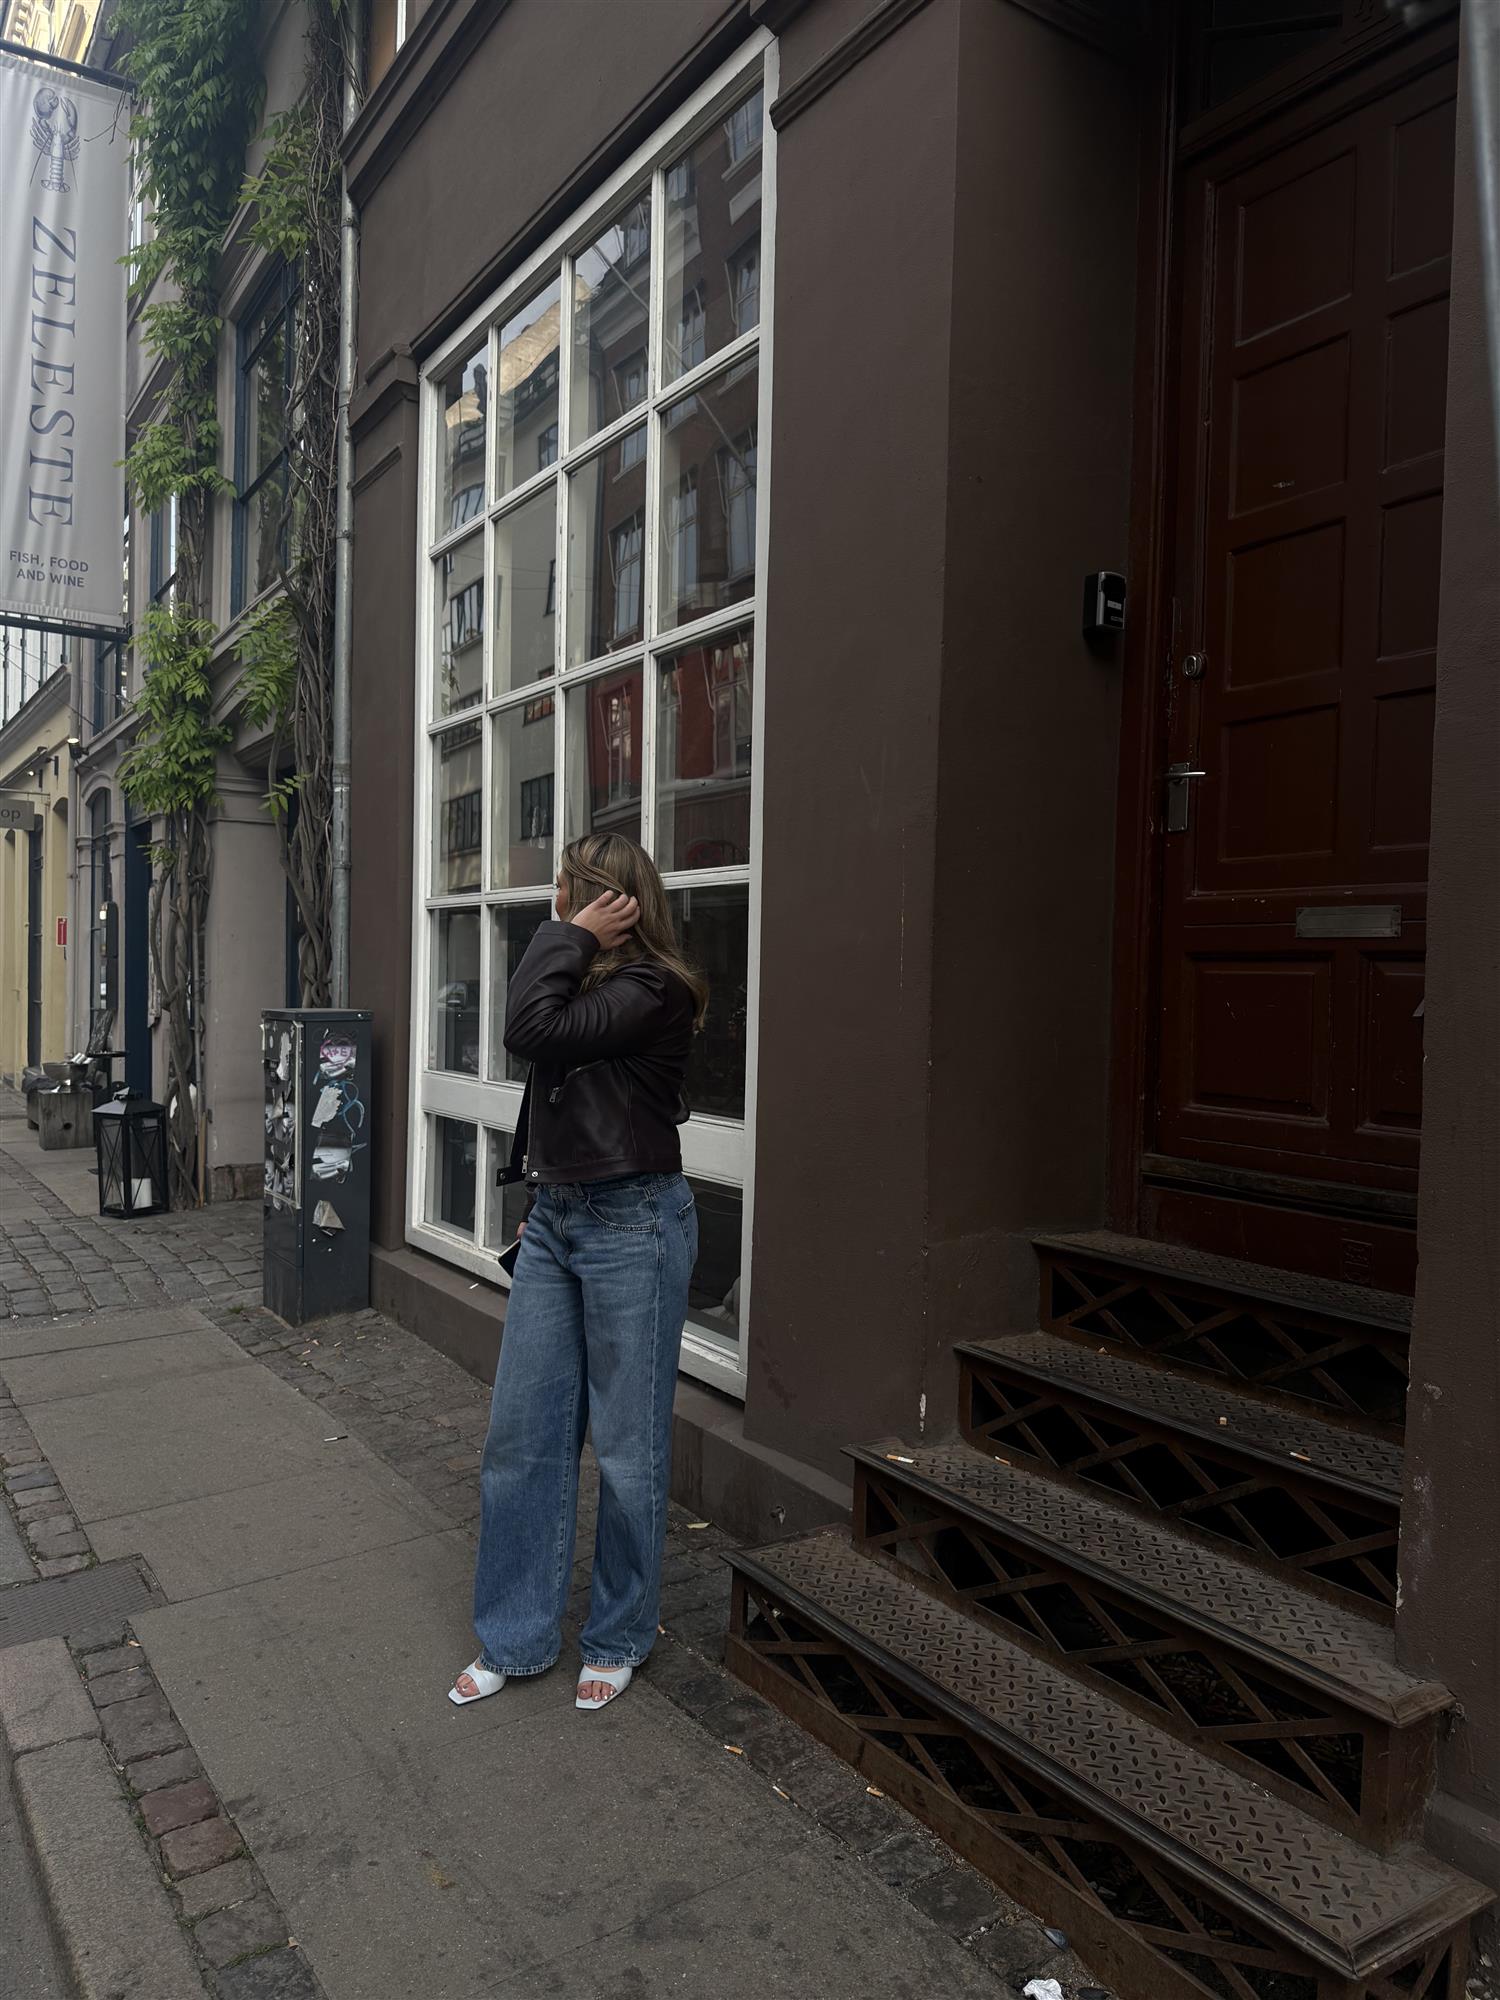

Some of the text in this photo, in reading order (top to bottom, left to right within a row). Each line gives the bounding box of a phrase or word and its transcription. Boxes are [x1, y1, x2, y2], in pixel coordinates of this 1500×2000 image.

[28, 215, 77, 527] ZELESTE
[9, 550, 89, 572] FISH, FOOD
[16, 568, 85, 588] AND WINE
